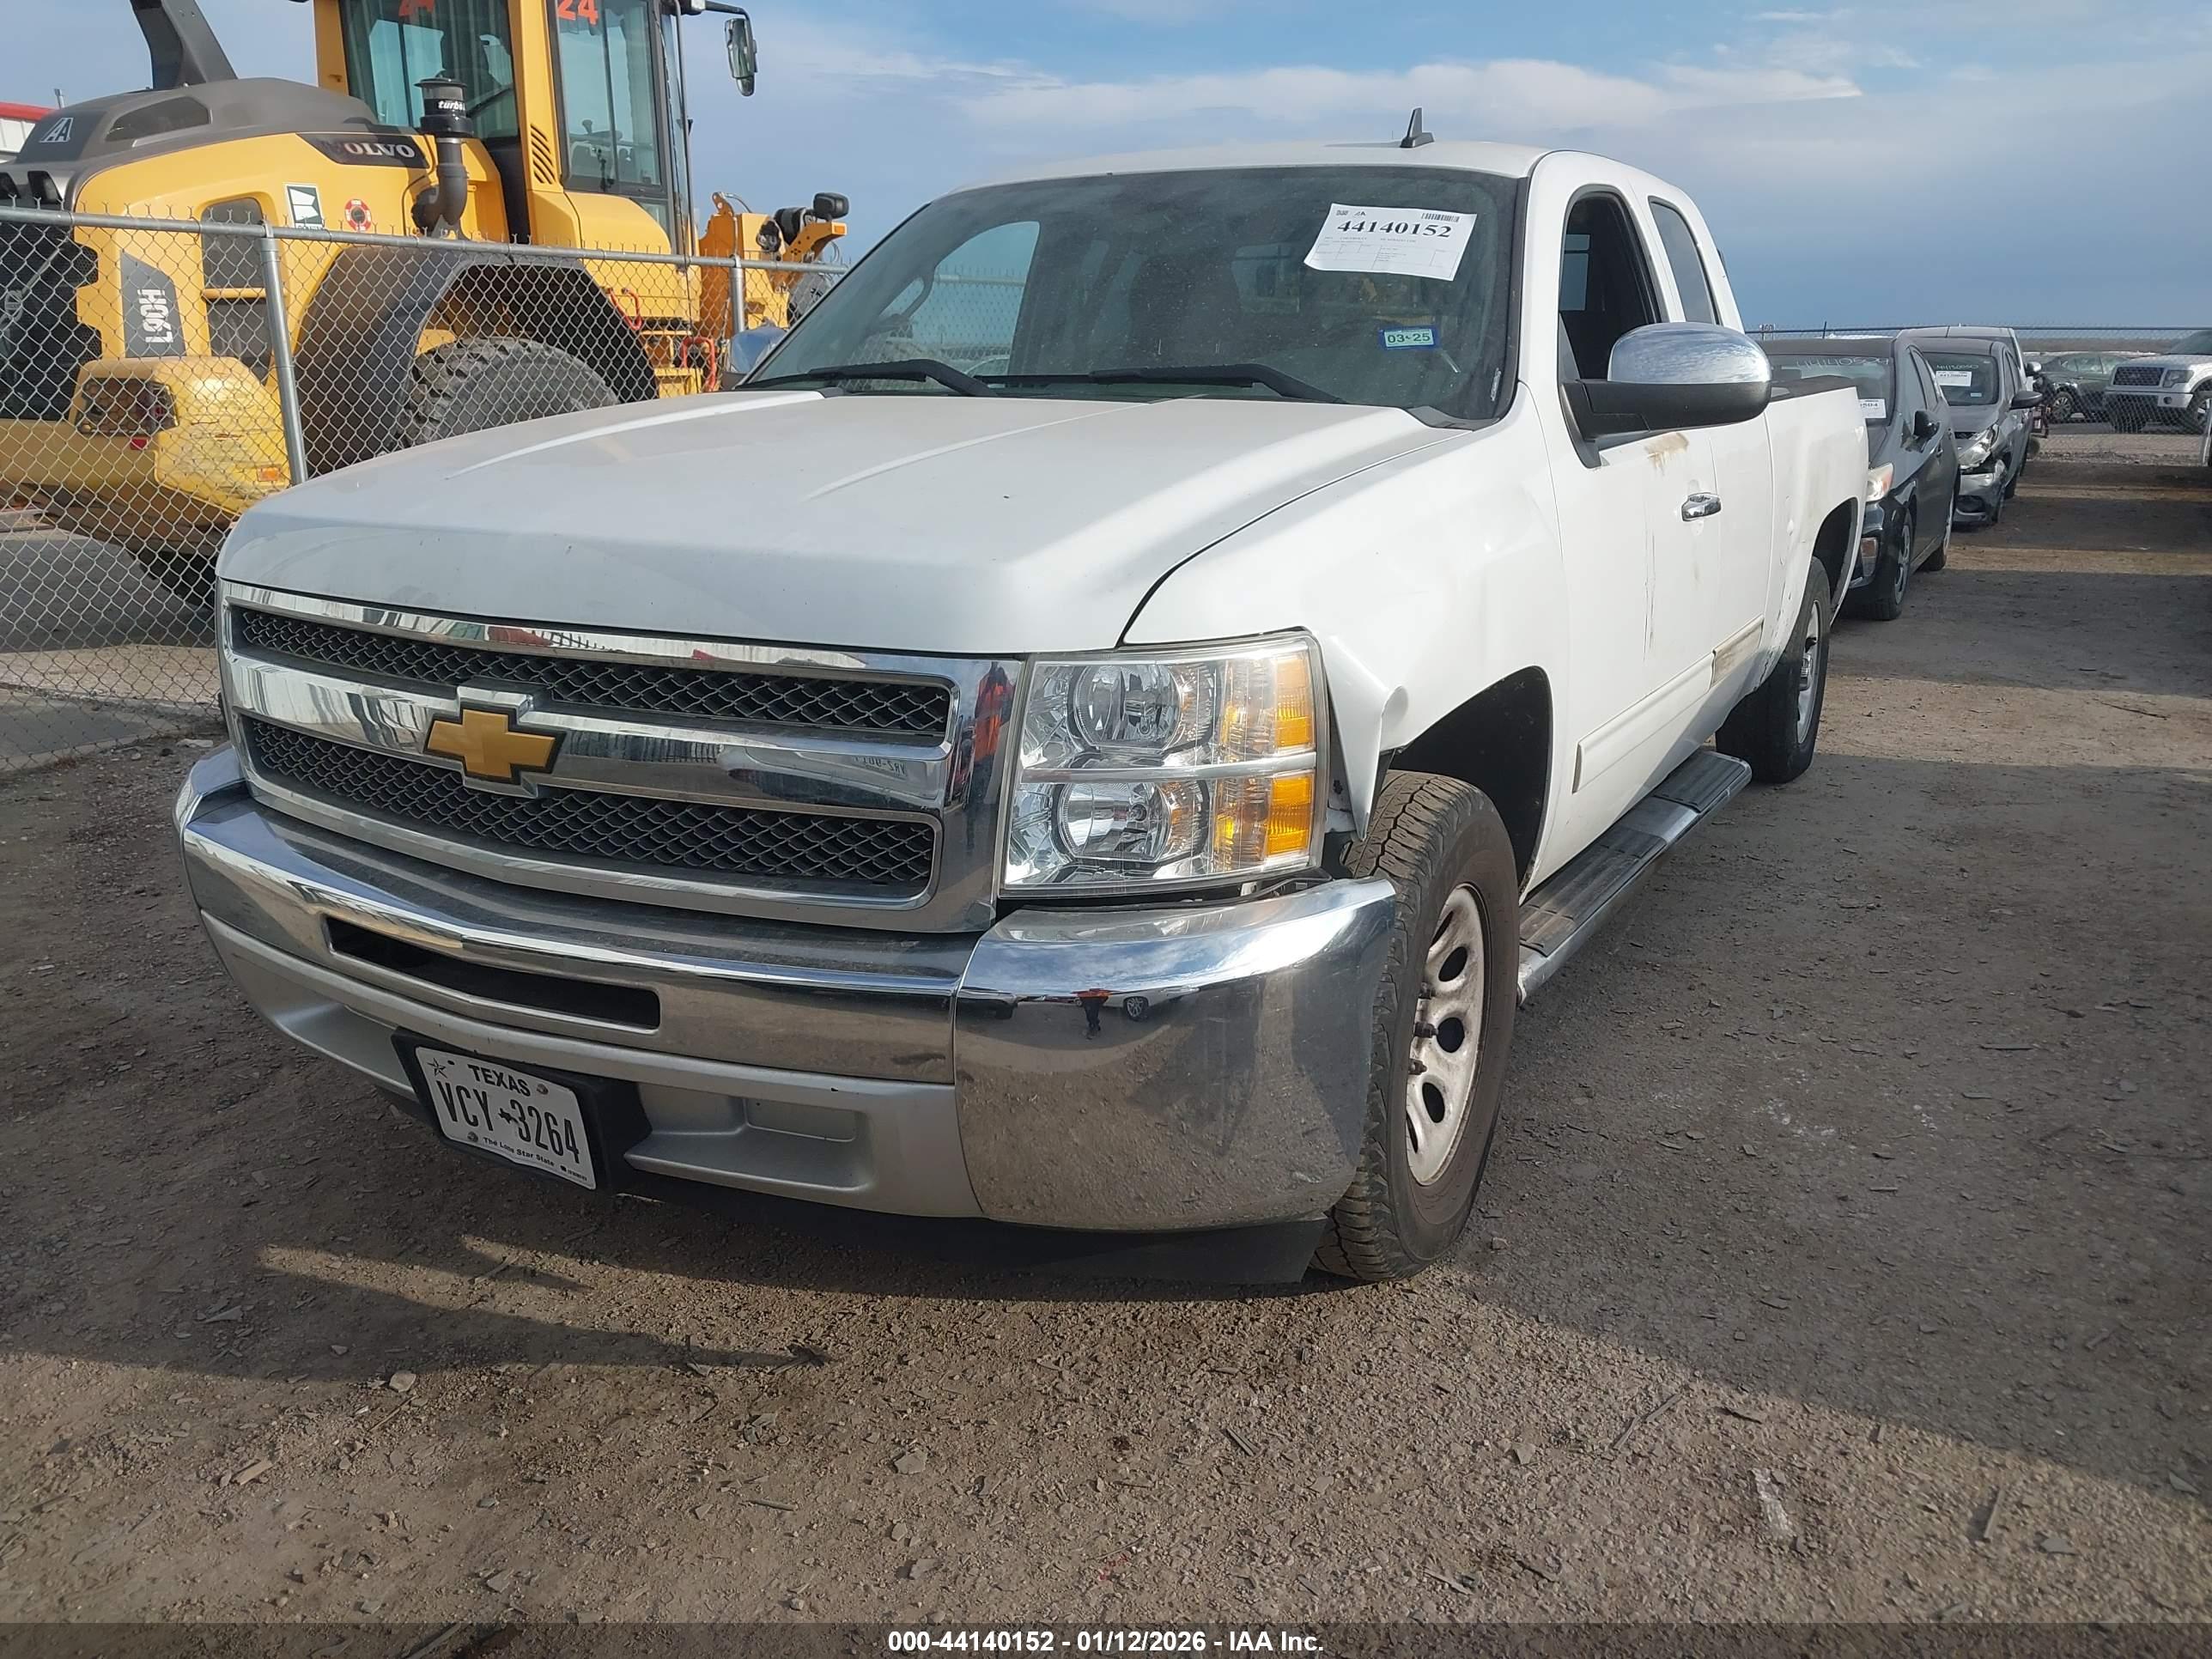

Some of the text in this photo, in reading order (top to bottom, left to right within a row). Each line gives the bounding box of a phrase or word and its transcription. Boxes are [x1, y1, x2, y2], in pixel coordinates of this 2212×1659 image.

[558, 0, 599, 25] 24
[331, 142, 416, 158] OLVO
[1337, 221, 1452, 238] 44140152
[467, 1064, 531, 1097] TEXAS
[483, 1136, 498, 1146] The
[516, 1148, 534, 1158] Star
[535, 1154, 556, 1167] State
